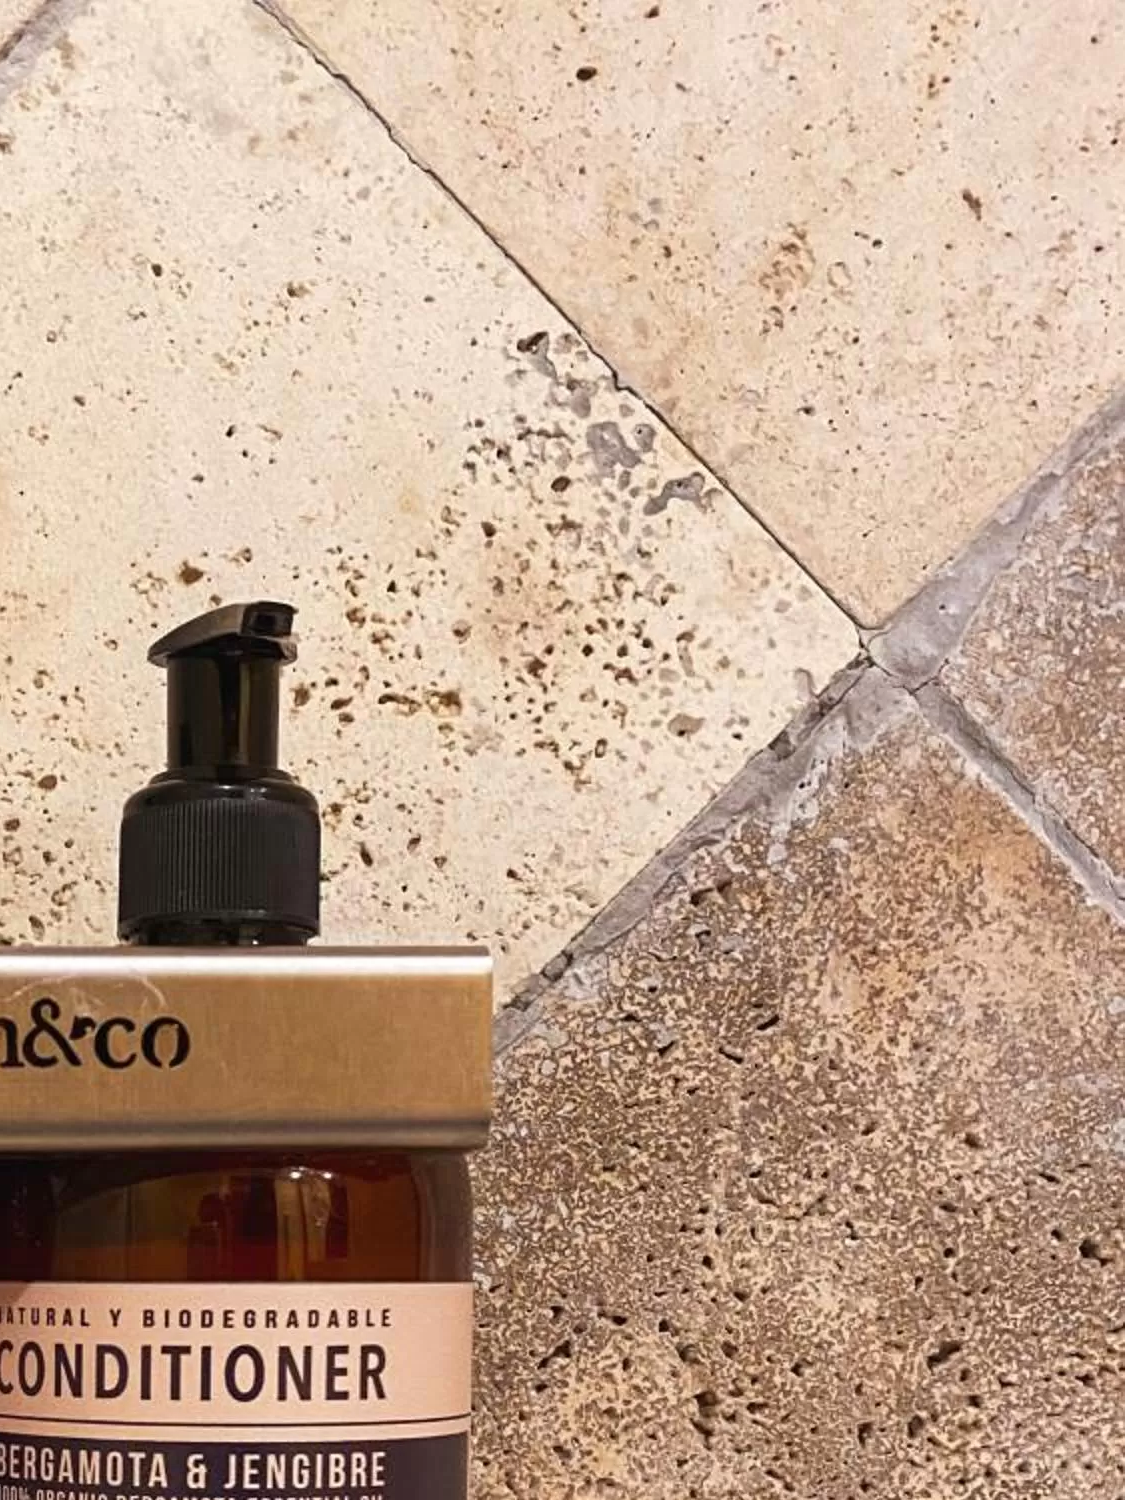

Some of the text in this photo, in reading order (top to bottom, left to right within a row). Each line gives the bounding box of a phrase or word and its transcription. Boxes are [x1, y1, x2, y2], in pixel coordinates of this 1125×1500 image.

[110, 1308, 121, 1327] Y
[143, 1308, 392, 1329] BIODEGRADABLE
[186, 1454, 207, 1489] &
[224, 1451, 386, 1490] JENGIBRE
